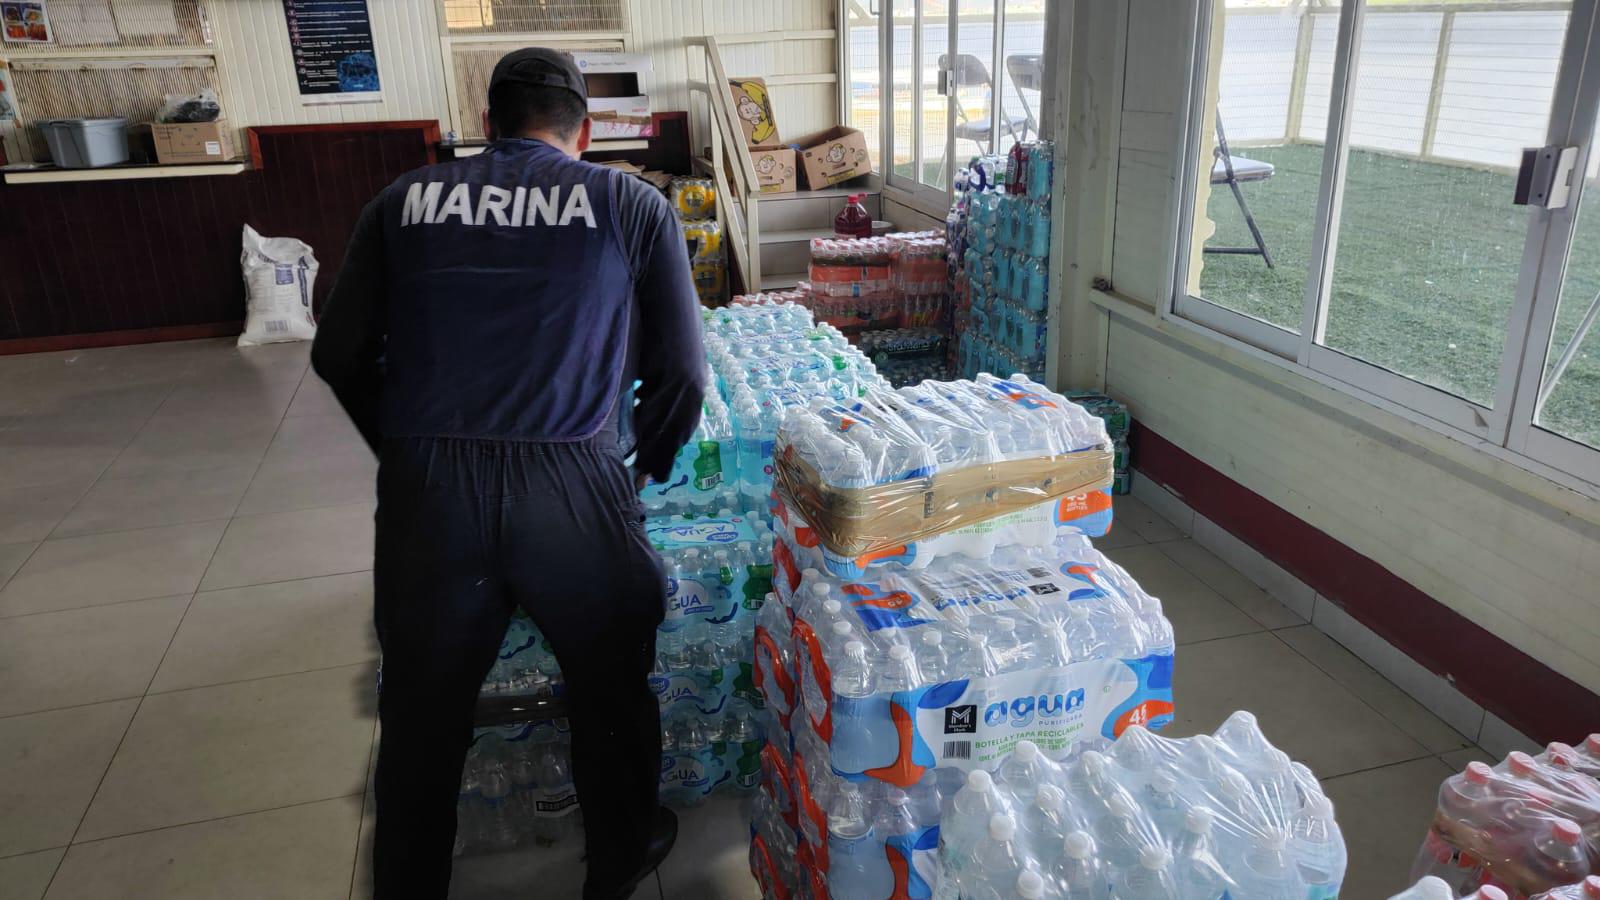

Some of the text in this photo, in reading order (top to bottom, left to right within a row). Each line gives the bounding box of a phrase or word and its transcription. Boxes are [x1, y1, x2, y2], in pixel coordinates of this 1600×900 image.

[401, 181, 598, 229] MARINA
[984, 687, 1085, 728] agua
[975, 736, 1009, 749] BOTELLA
[1016, 731, 1036, 740] TAPA
